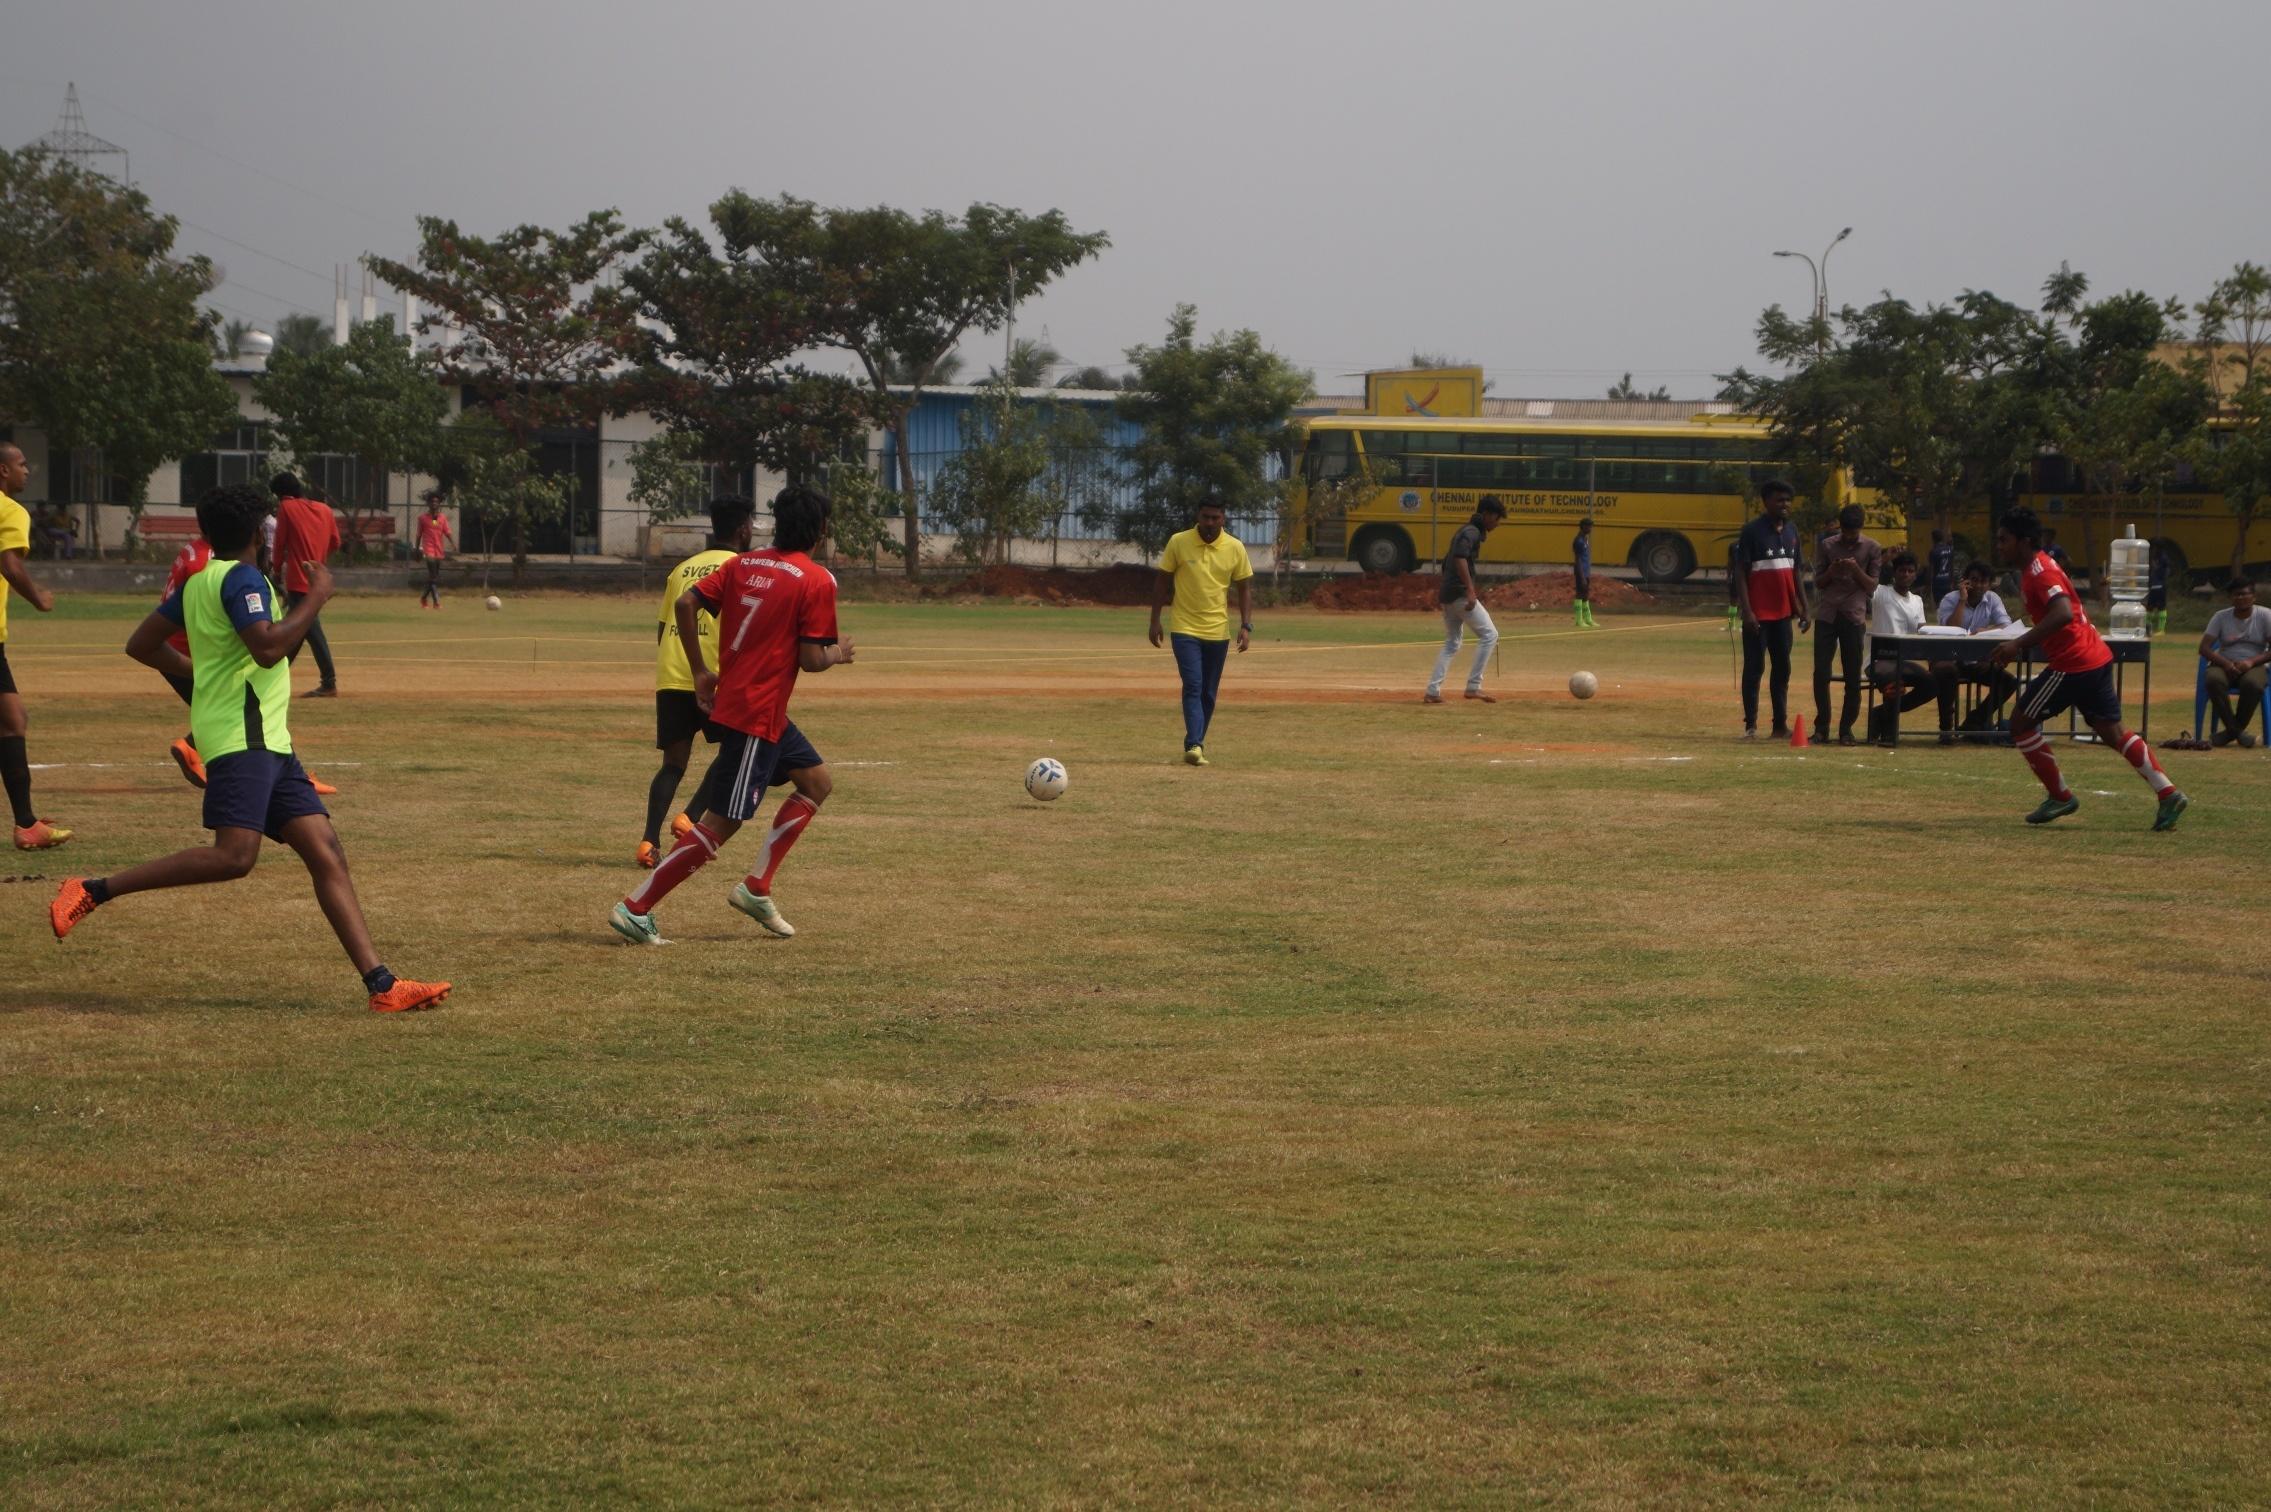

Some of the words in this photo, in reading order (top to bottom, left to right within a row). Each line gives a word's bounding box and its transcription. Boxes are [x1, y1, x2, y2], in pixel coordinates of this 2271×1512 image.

[1430, 491, 1476, 504] CHENNAI
[1478, 492, 1531, 505] ITITUTE
[1533, 494, 1547, 505] OF
[730, 594, 763, 651] 7
